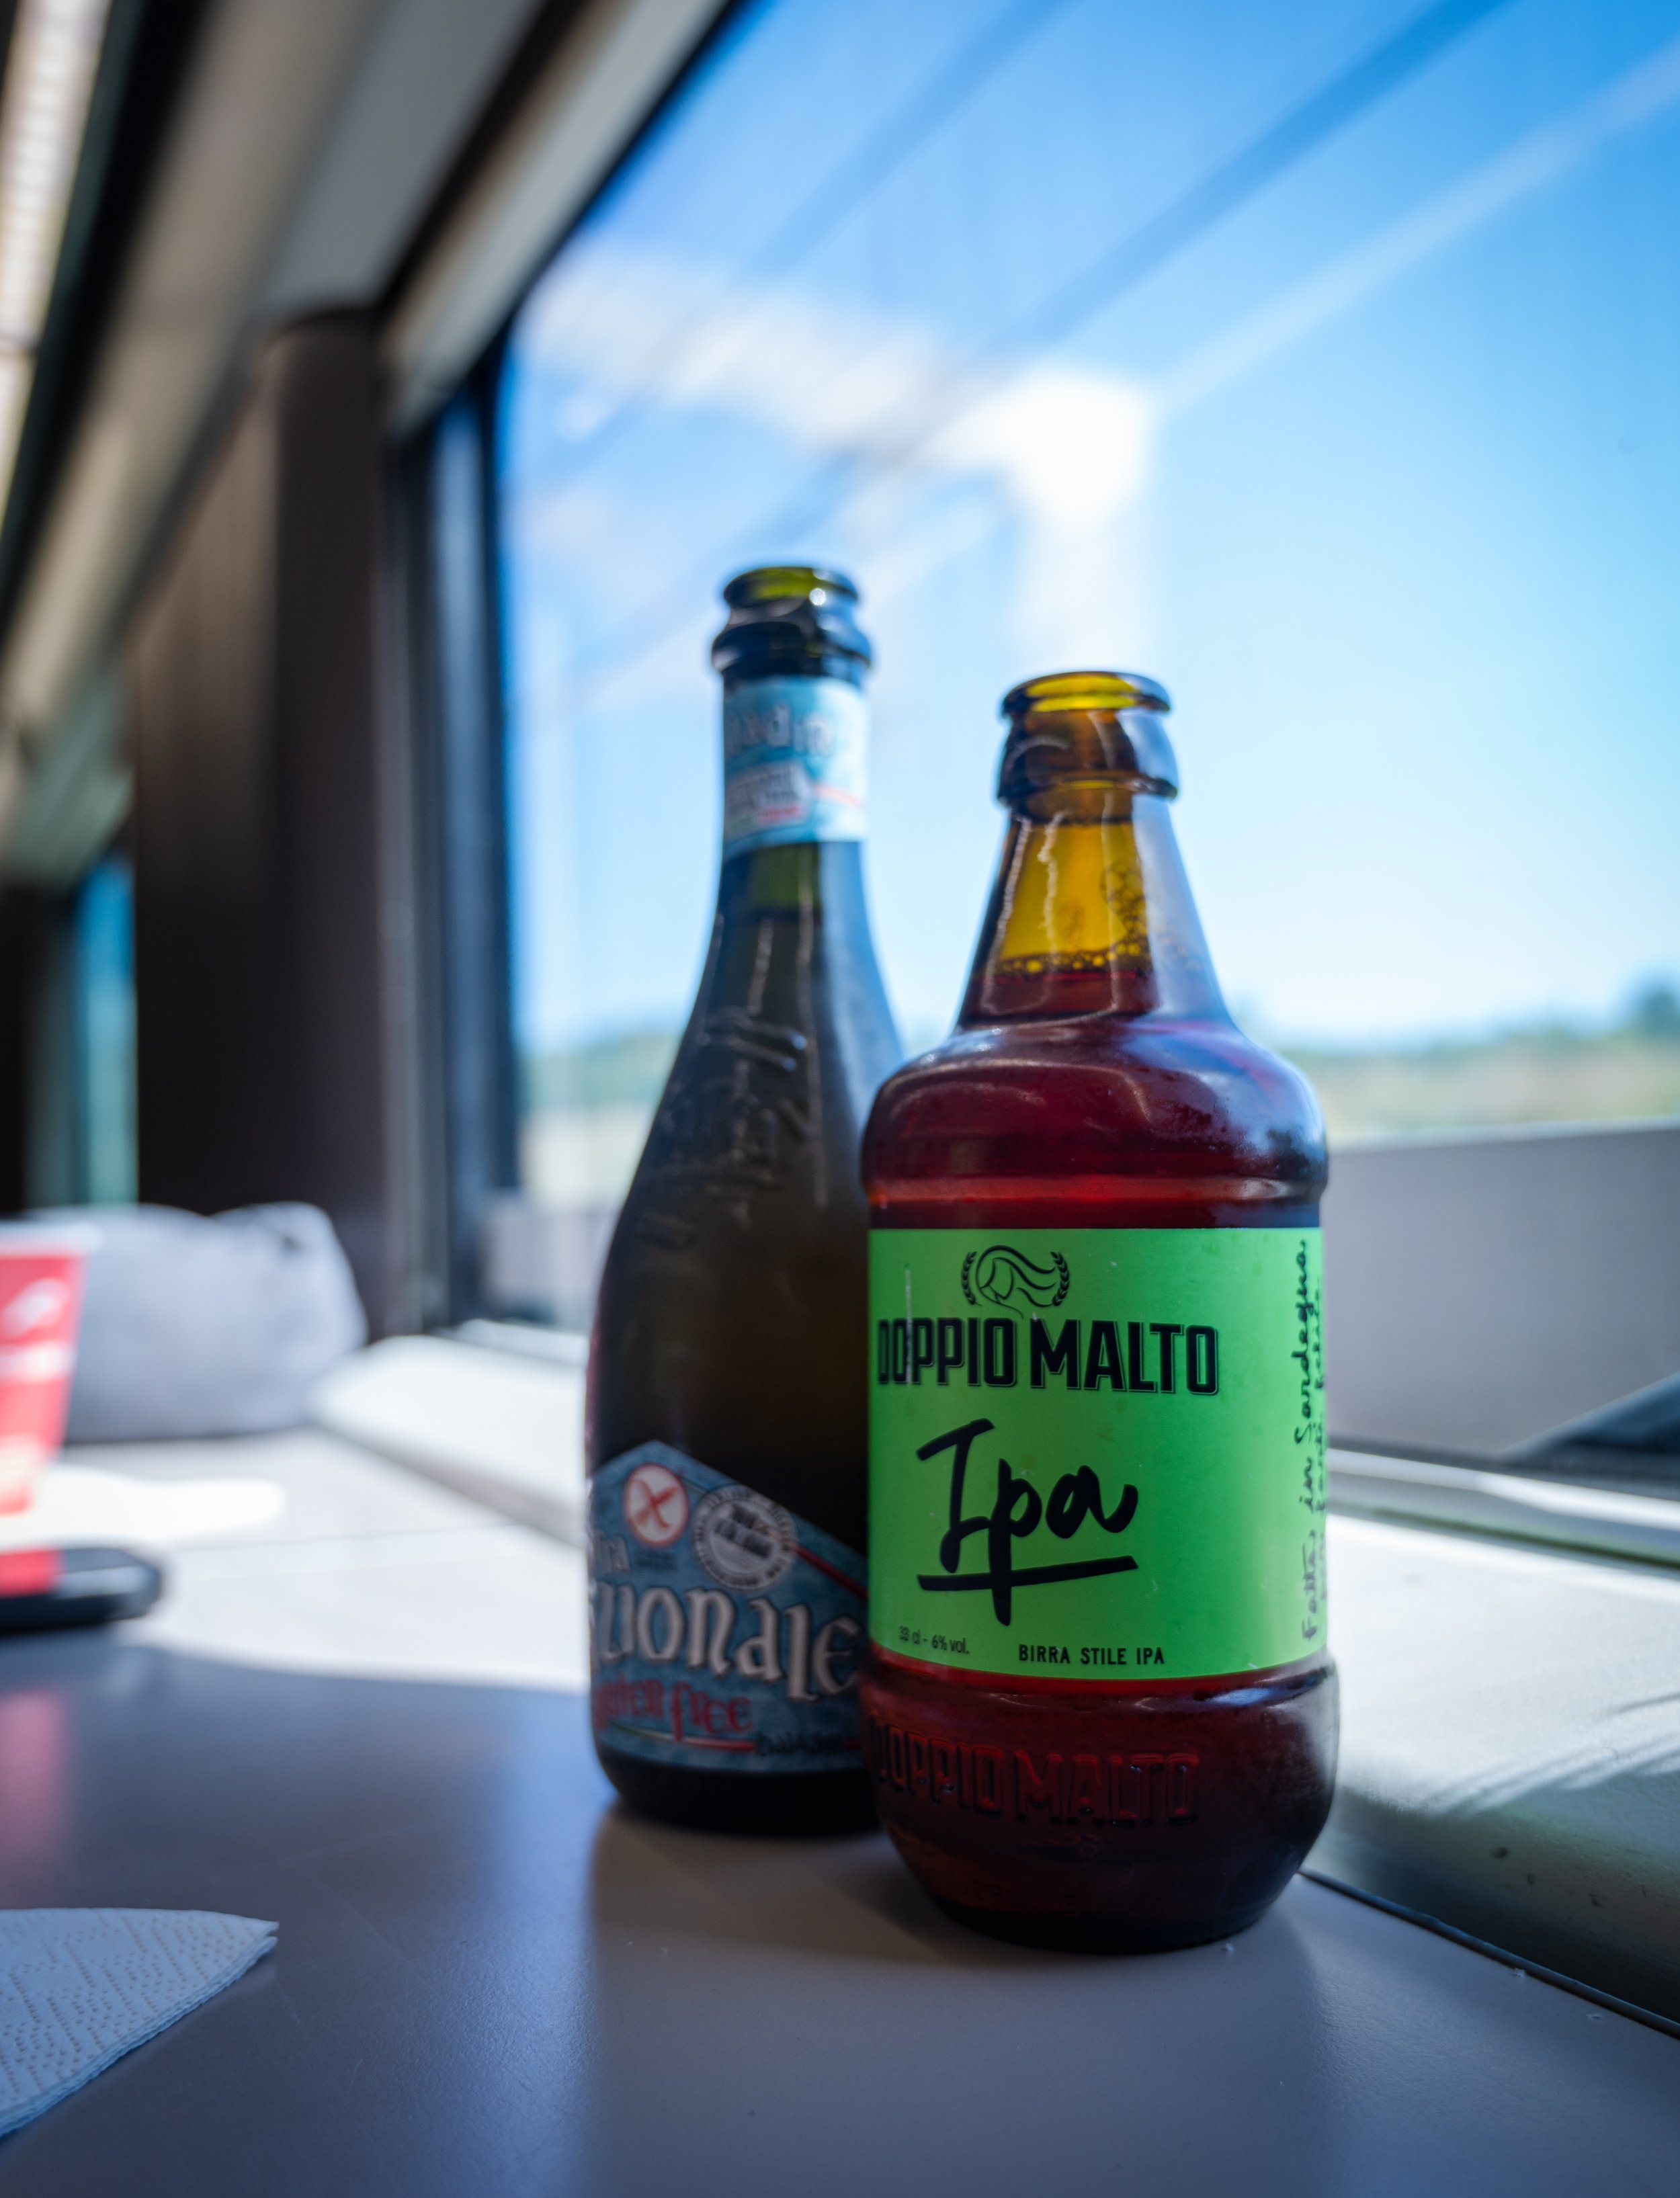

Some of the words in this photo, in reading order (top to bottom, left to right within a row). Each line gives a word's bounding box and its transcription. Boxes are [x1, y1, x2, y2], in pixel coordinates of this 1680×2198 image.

[877, 1316, 1017, 1389] DOPPIO
[1030, 1318, 1219, 1396] MALTO
[1290, 1240, 1314, 1445] Sardegna
[915, 1418, 1138, 1626] Ipa
[1298, 1457, 1314, 1513] in
[899, 1625, 909, 1642] 33
[931, 1634, 948, 1651] 6%
[950, 1638, 970, 1654] vol.
[1018, 1644, 1070, 1664] BIRRA
[1080, 1646, 1128, 1665] STILE
[1136, 1644, 1165, 1665] IPA
[1013, 1750, 1200, 1828] MALTO
